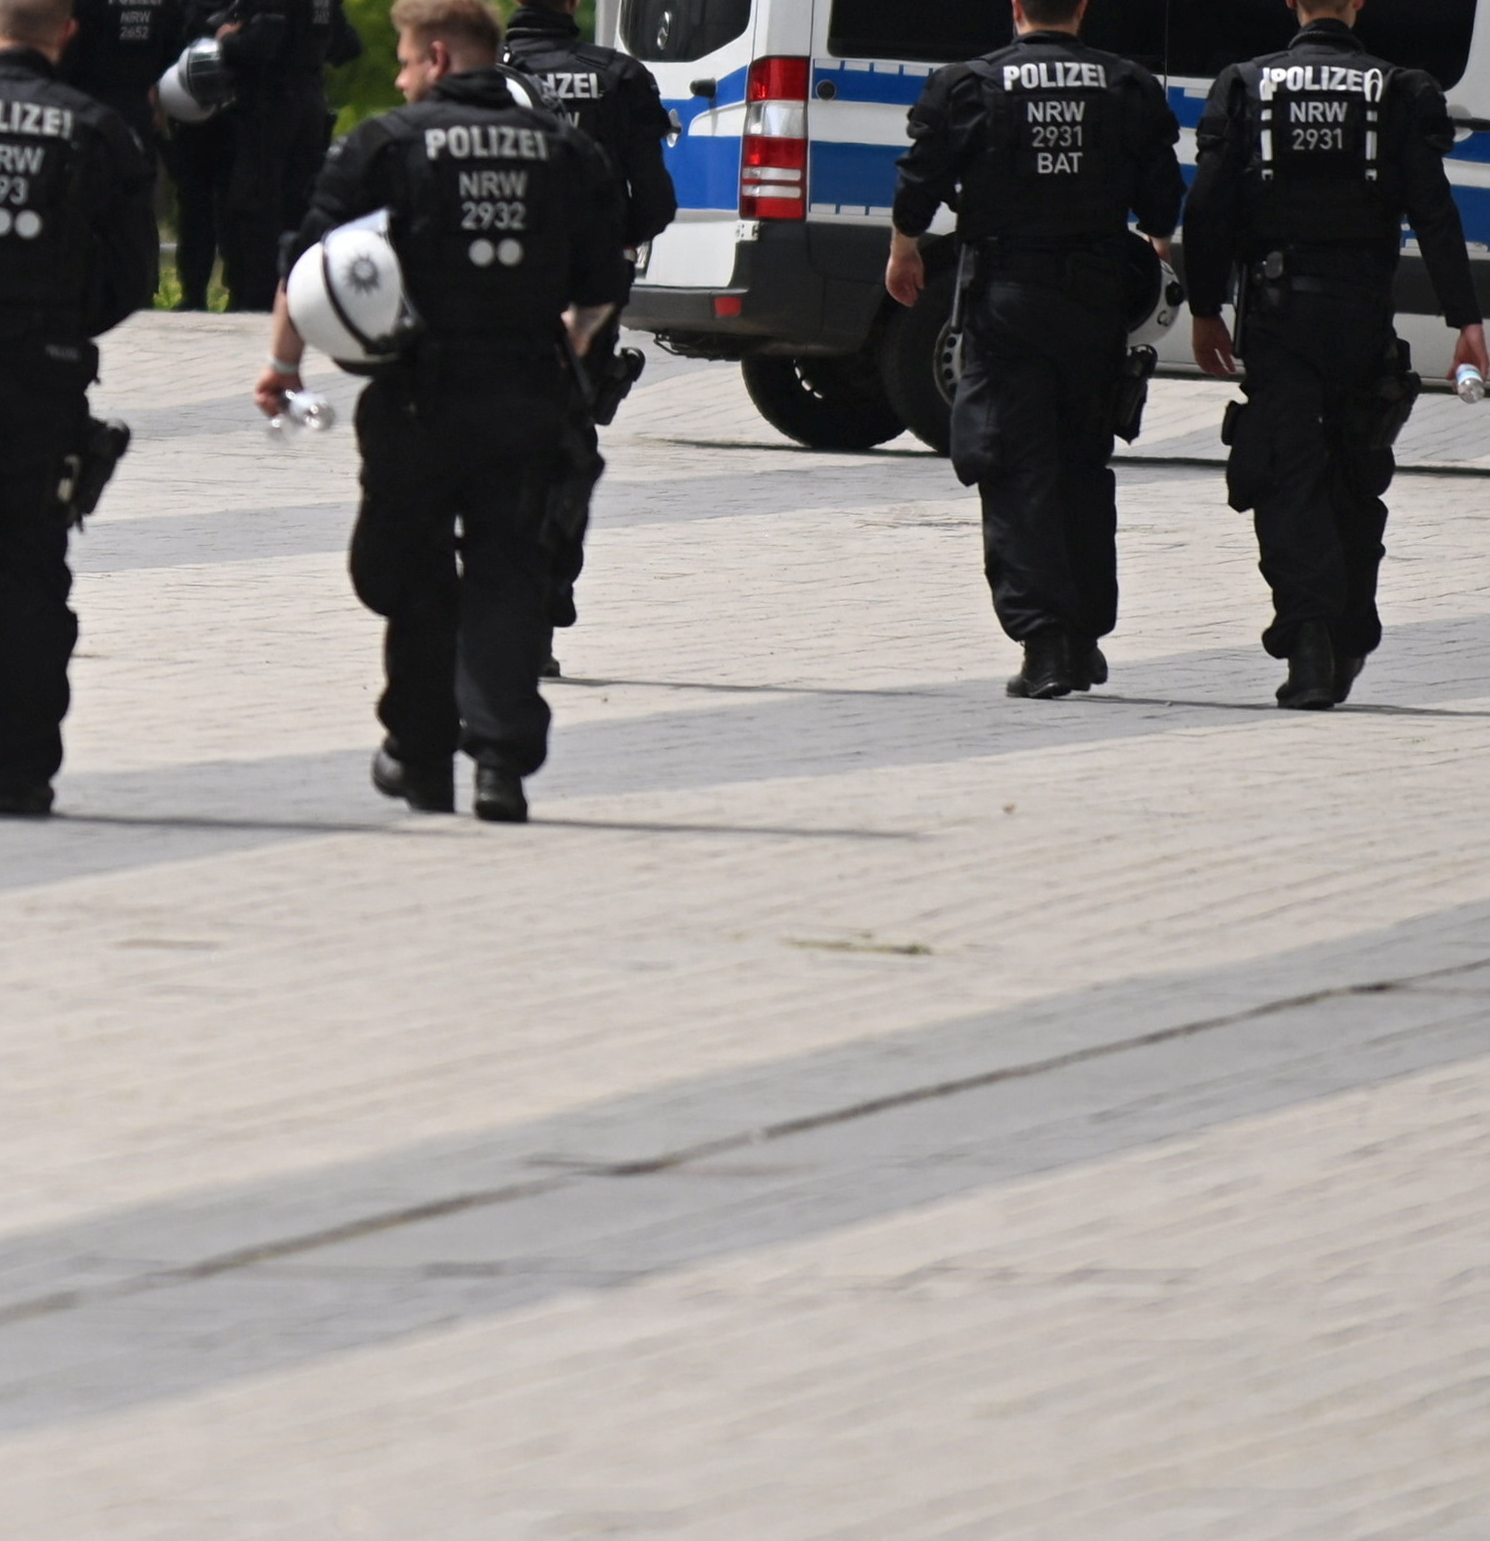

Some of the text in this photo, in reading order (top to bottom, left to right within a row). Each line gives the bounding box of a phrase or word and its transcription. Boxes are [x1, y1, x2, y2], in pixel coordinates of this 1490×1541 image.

[120, 10, 151, 24] NRW
[1003, 62, 1108, 91] POLIZEI
[1027, 101, 1085, 123] NRW
[1289, 101, 1348, 123] NRW
[425, 125, 549, 160] POLIZEI
[1031, 125, 1083, 147] 2931
[1292, 127, 1343, 150] 2931
[1037, 151, 1084, 174] BAT
[458, 170, 528, 199] NRW
[460, 201, 527, 230] 2932
